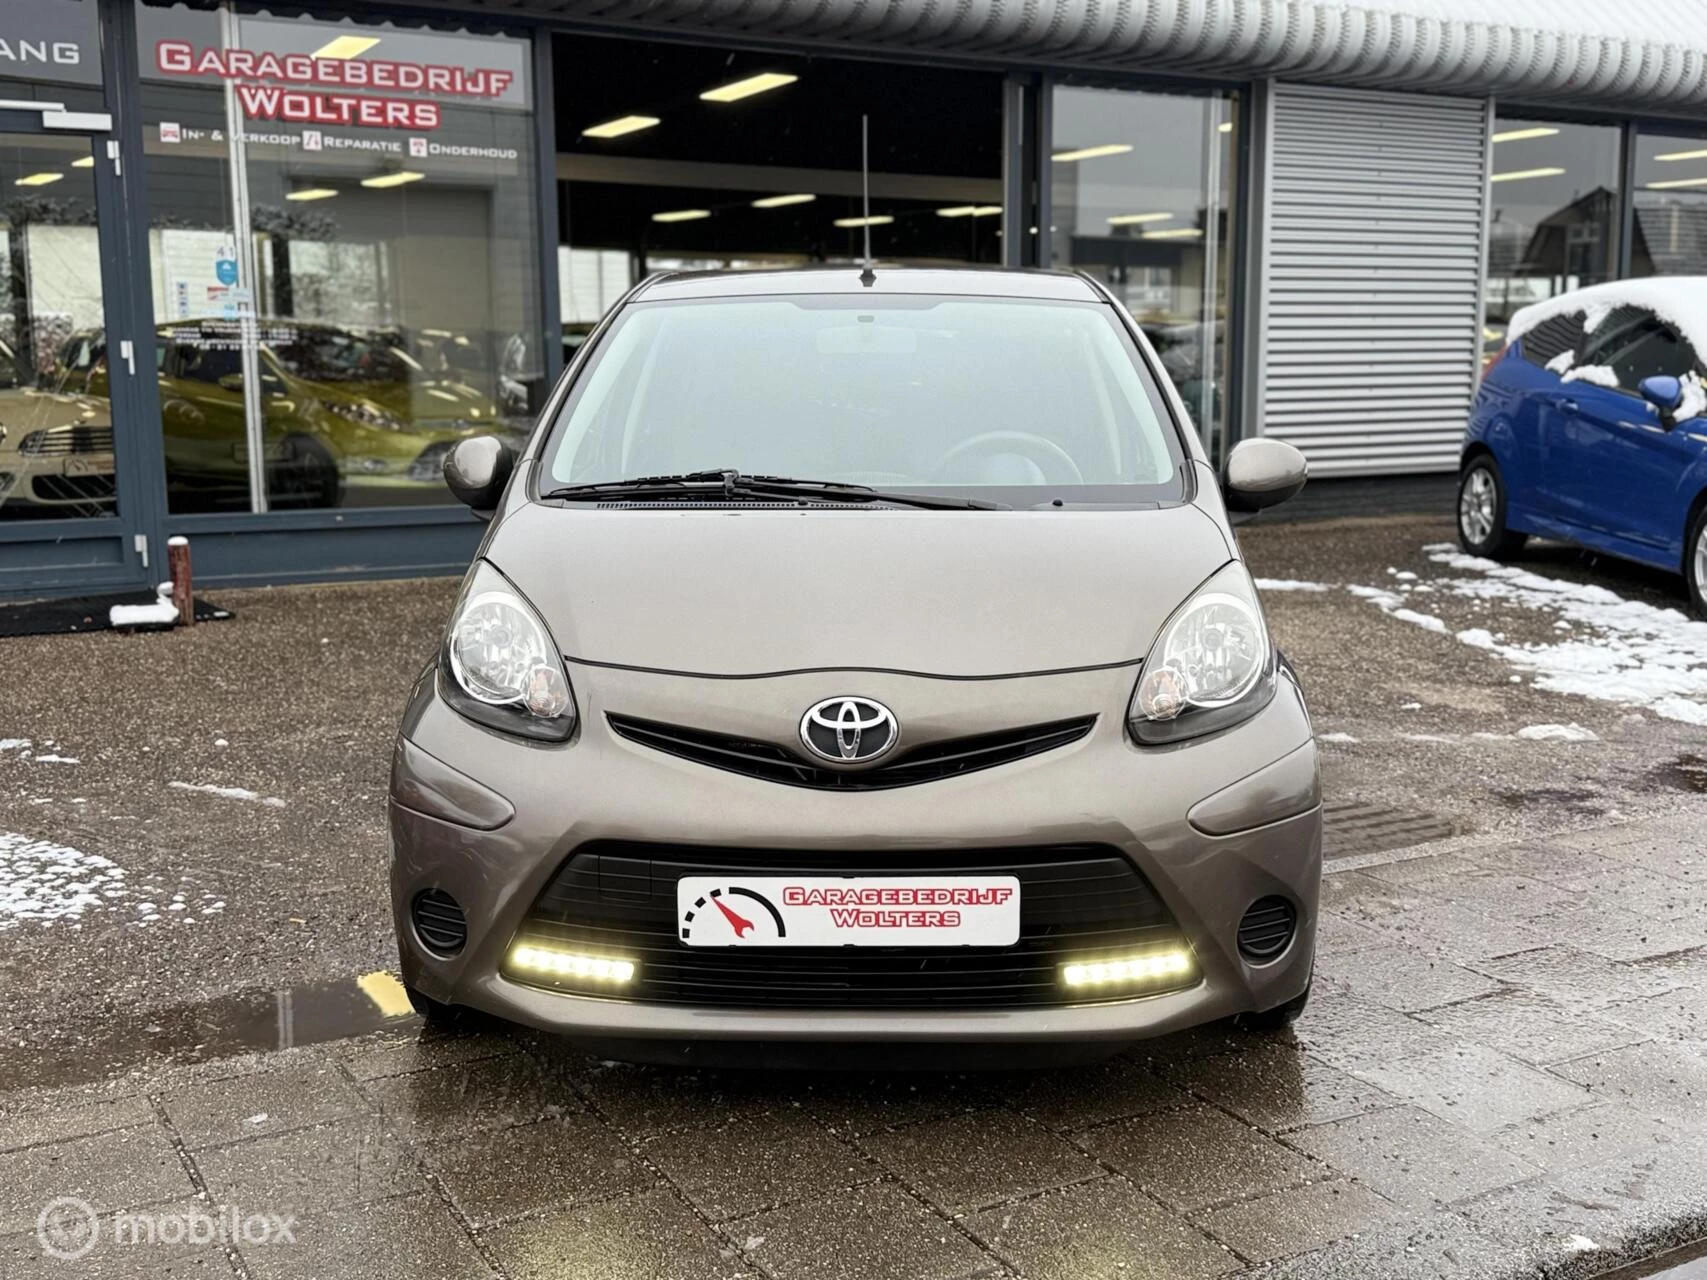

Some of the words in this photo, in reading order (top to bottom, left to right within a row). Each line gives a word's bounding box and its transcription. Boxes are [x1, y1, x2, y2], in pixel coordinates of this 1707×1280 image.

[156, 40, 513, 97] GARAGEBEDRIJF
[236, 83, 440, 131] WOLTERS
[211, 130, 224, 141] &
[323, 136, 401, 151] REPARATIE
[429, 143, 518, 159] ONDERHOUD
[783, 887, 1013, 906] GARAGEBEDRIJF
[830, 908, 961, 928] WOLTERS
